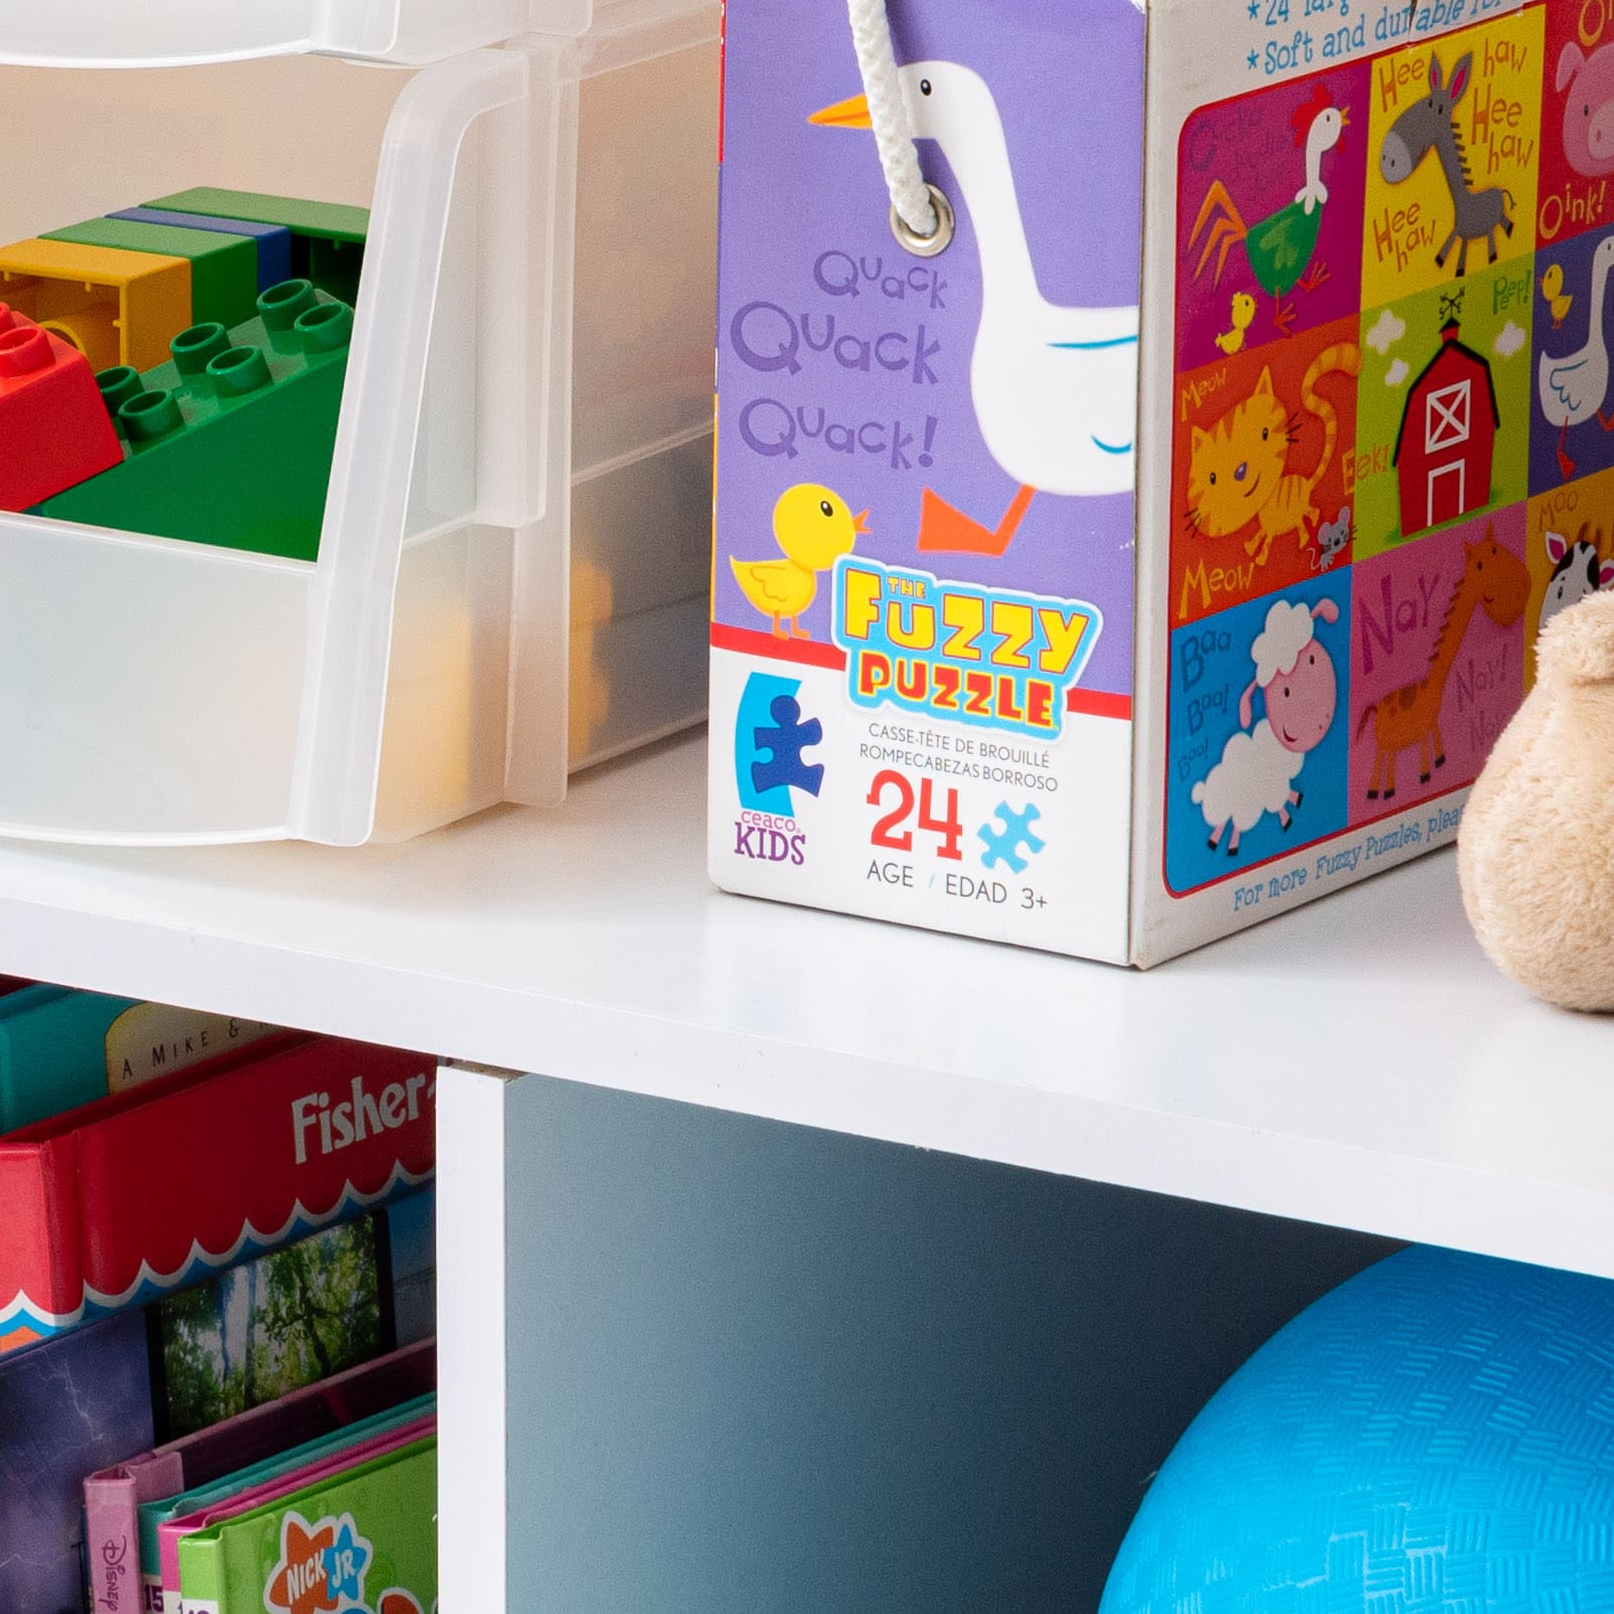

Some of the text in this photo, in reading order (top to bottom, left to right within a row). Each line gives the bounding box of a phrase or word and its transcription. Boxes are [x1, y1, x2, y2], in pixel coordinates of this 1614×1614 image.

[1322, 16, 1366, 59] and
[1379, 36, 1528, 113] Hee haw
[1471, 85, 1523, 146] Hee
[1487, 131, 1535, 174] haw
[1373, 201, 1420, 262] Hee
[1539, 181, 1607, 240] Oink!
[1395, 219, 1436, 273] haw
[813, 250, 948, 310] Quack
[730, 301, 941, 384] Quack
[1181, 367, 1228, 423] Meow
[739, 397, 938, 471] Quack!
[887, 576, 926, 599] THE
[1178, 555, 1255, 620] Meow
[844, 567, 1090, 675] FUZZY
[858, 651, 1055, 729] PUZZLE
[1180, 629, 1232, 695] Baa
[1187, 683, 1229, 736] Baa!
[859, 746, 1059, 793] ROMPECABEZAS BORROSO
[868, 722, 1051, 769] CASSE-TÊTE DE BROUILLÉ
[734, 821, 806, 866] KIDS
[866, 769, 963, 861] 24
[866, 859, 1048, 911] AGE EDAD 3+
[1234, 886, 1264, 912] For
[1268, 869, 1308, 899] more
[1316, 844, 1361, 880] Fuzzy
[1365, 821, 1424, 860] Puzzles,
[122, 1058, 133, 1080] A
[229, 1017, 240, 1039] &
[98, 1535, 127, 1612] Disney
[287, 1548, 328, 1605] NICK
[332, 1549, 357, 1588] JR
